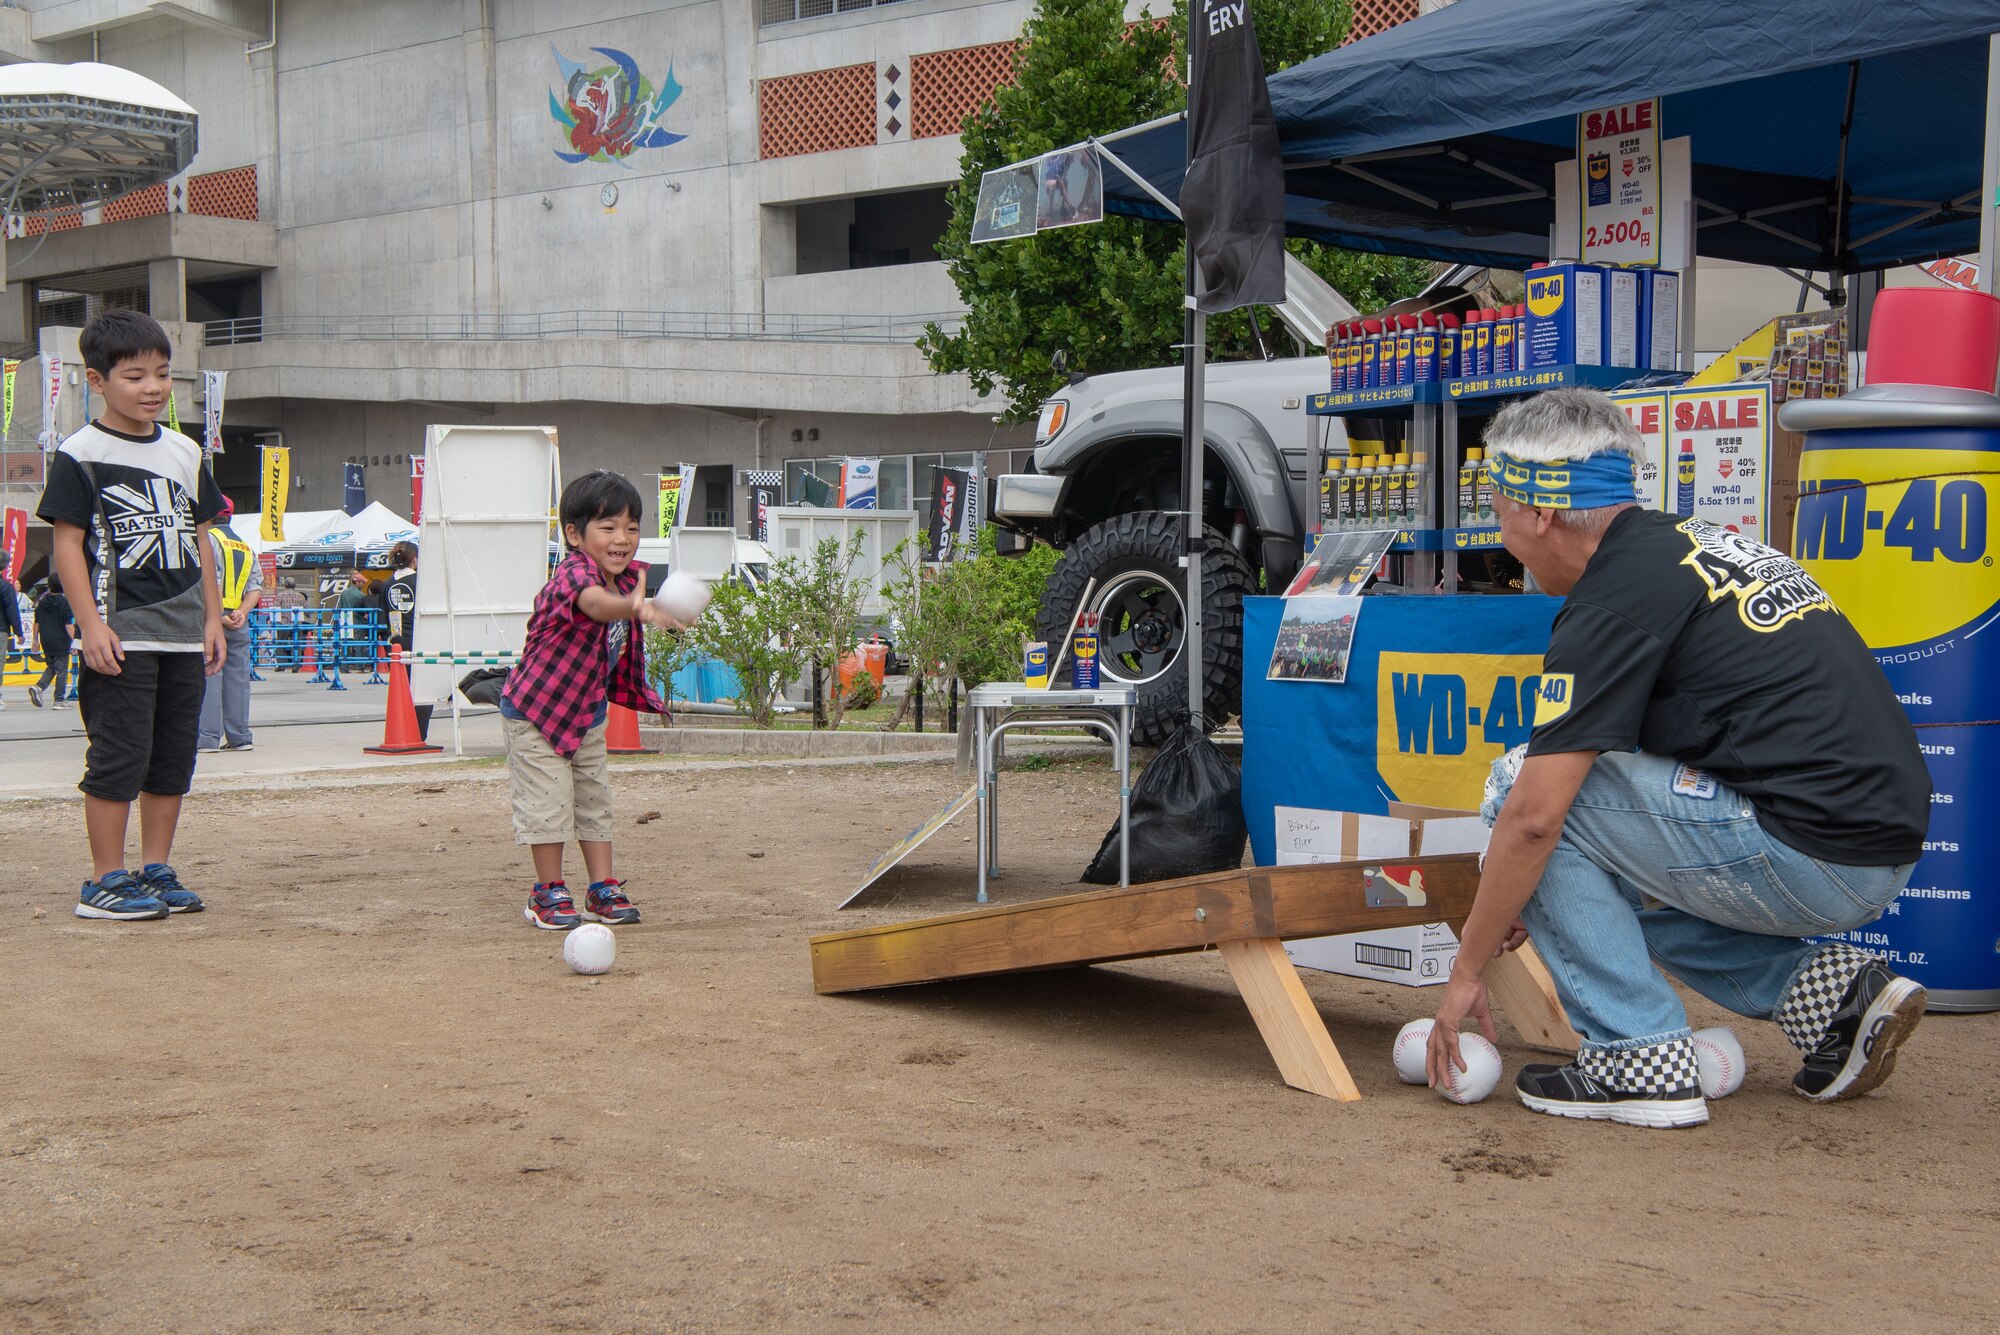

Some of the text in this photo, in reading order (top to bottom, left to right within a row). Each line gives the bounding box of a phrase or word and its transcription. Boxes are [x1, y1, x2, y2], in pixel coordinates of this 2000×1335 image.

[1586, 102, 1652, 140] SALE
[1637, 156, 1651, 164] 30%
[1639, 165, 1652, 173] OFF
[1624, 189, 1642, 197] Gallon
[1586, 220, 1650, 247] 2,500円
[1927, 259, 1978, 291] MA
[1530, 279, 1560, 300] WD-40
[1674, 398, 1759, 431] SALE
[1538, 473, 1567, 482] WD-40
[1712, 485, 1740, 494] WD-40
[270, 466, 281, 538] DUNLOP
[1537, 496, 1568, 504] WD-40
[1744, 496, 1755, 504] ml
[114, 515, 174, 534] BA-TSU
[938, 485, 955, 561] ADVAN
[1742, 516, 1757, 525] 税込
[1796, 478, 1987, 563] WD-40
[304, 553, 344, 563] racing team
[1751, 572, 1822, 620] OKINA
[1539, 678, 1567, 703] -40
[1850, 931, 1862, 942] IN
[1865, 932, 1889, 946] USA
